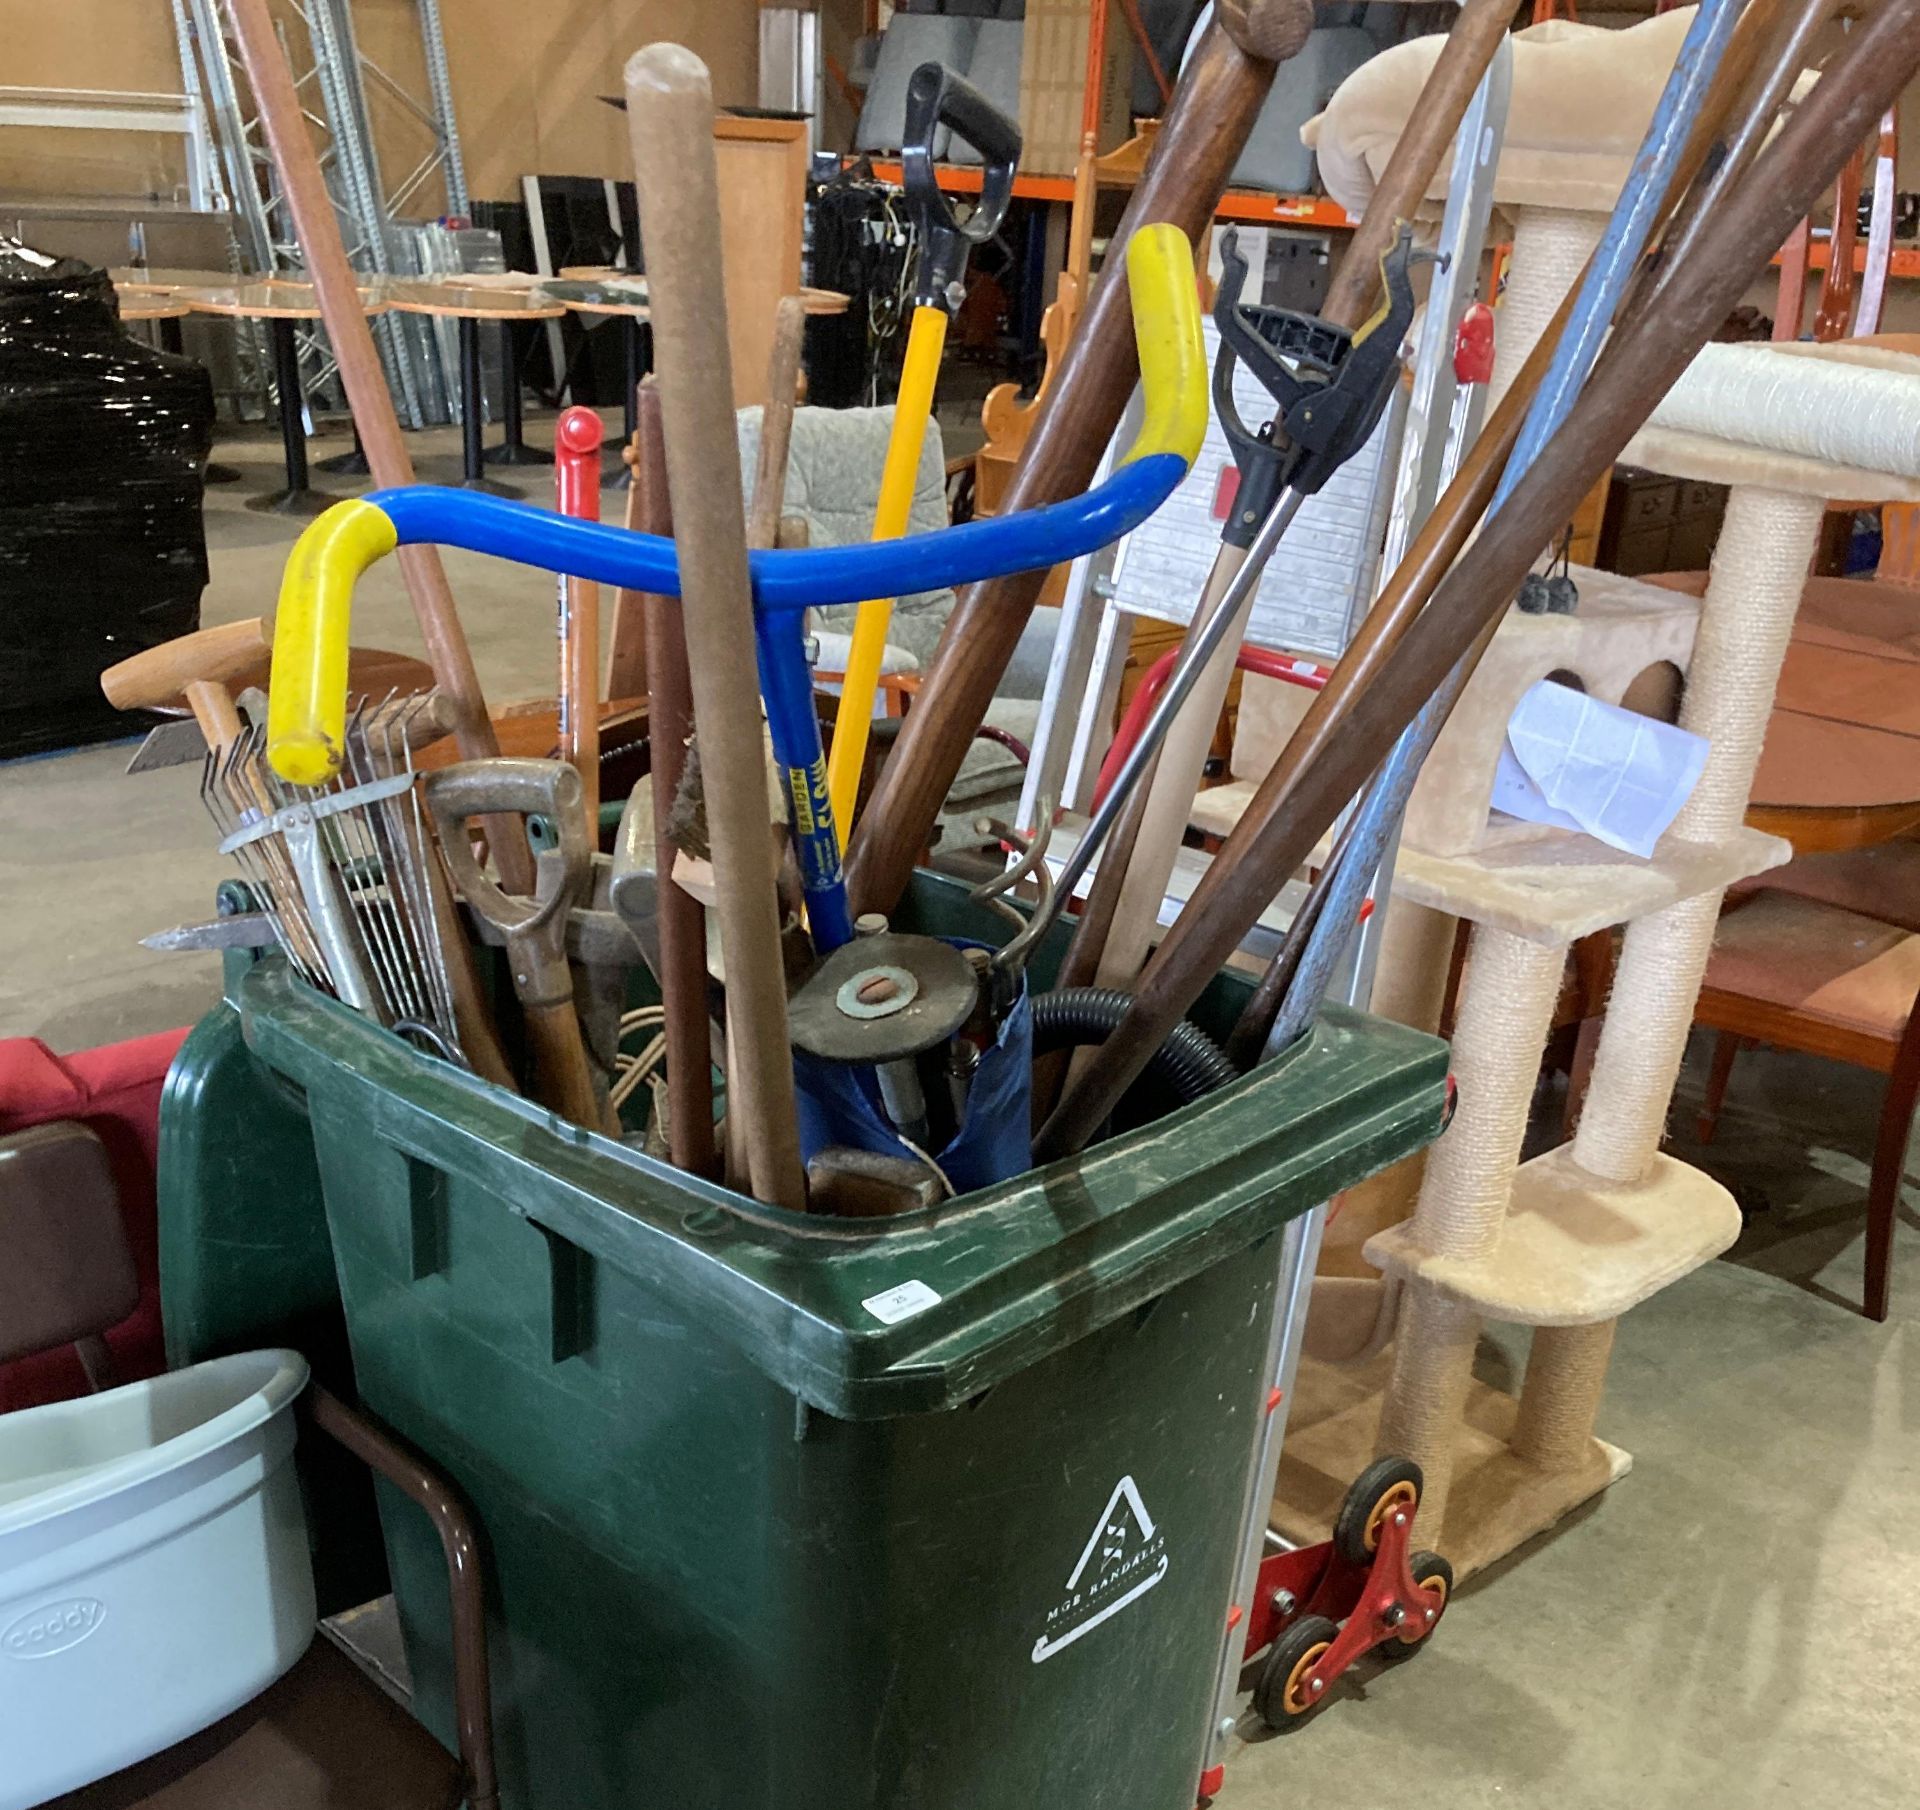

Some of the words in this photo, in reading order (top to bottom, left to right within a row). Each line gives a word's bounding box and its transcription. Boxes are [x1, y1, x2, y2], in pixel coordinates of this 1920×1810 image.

[790, 768, 815, 833] GARDEN
[1046, 1593, 1081, 1622] MGB
[1089, 1536, 1165, 1596] RANDALLS
[9, 1600, 98, 1648] caddy
